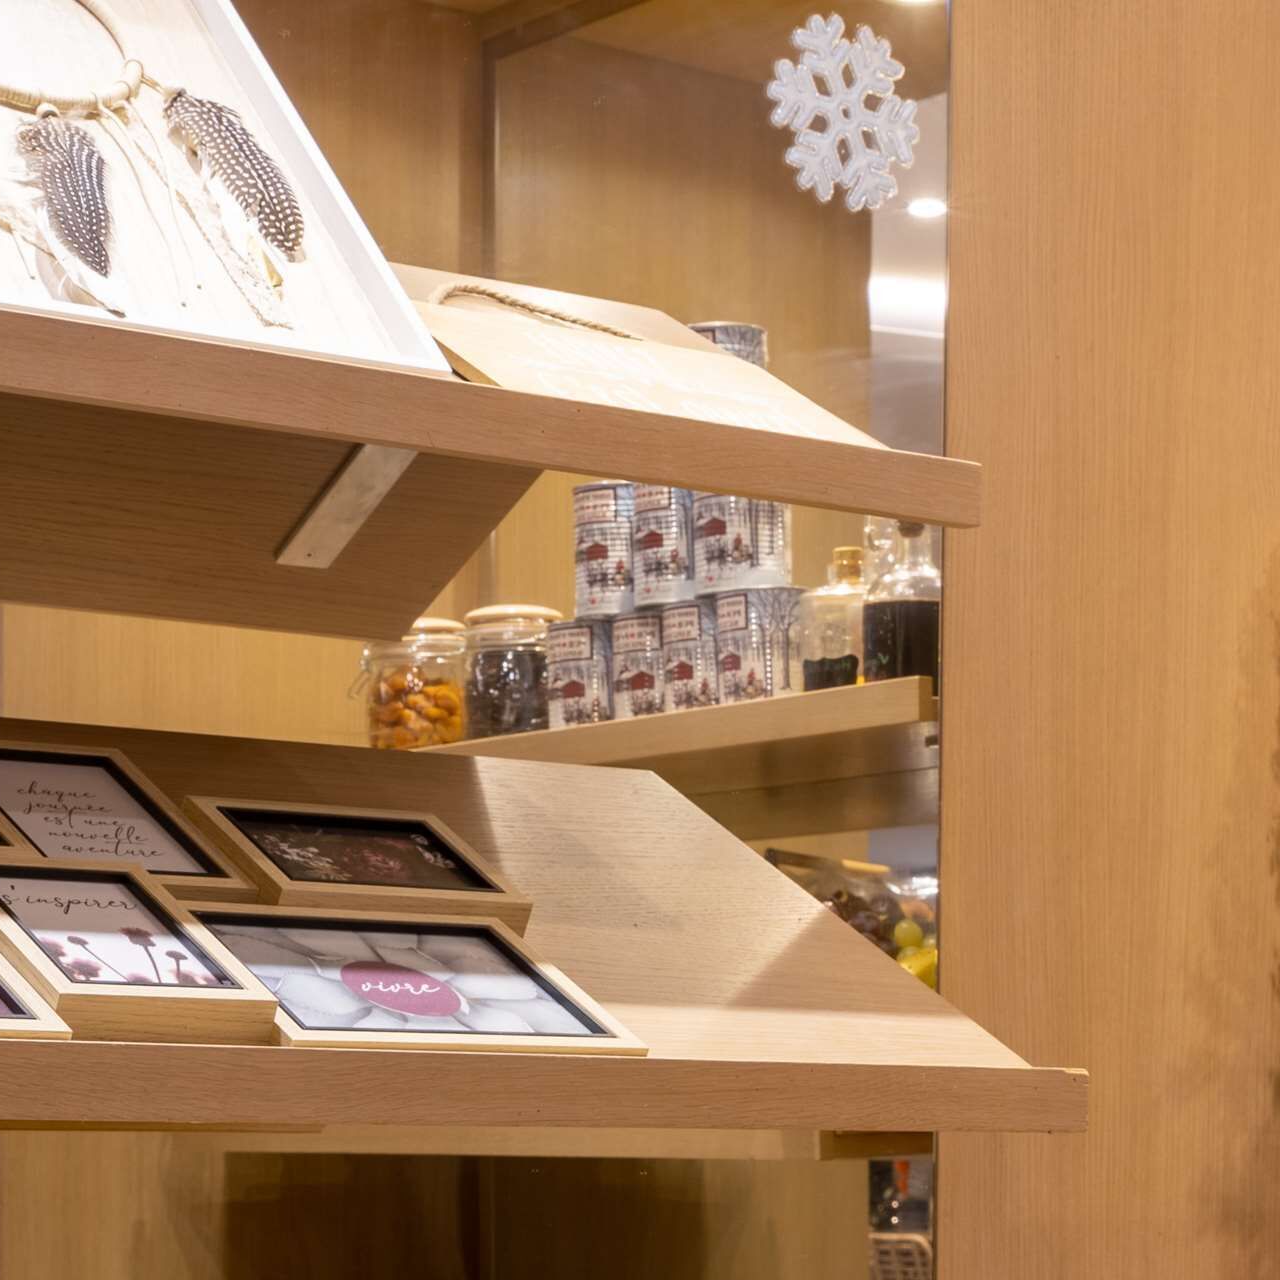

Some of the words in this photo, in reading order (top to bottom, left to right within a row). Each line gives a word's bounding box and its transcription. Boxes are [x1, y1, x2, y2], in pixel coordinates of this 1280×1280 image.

[17, 780, 96, 802] chaque
[48, 827, 149, 844] nouvelle
[62, 841, 163, 857] aventure
[1, 884, 138, 915] s'inspirer
